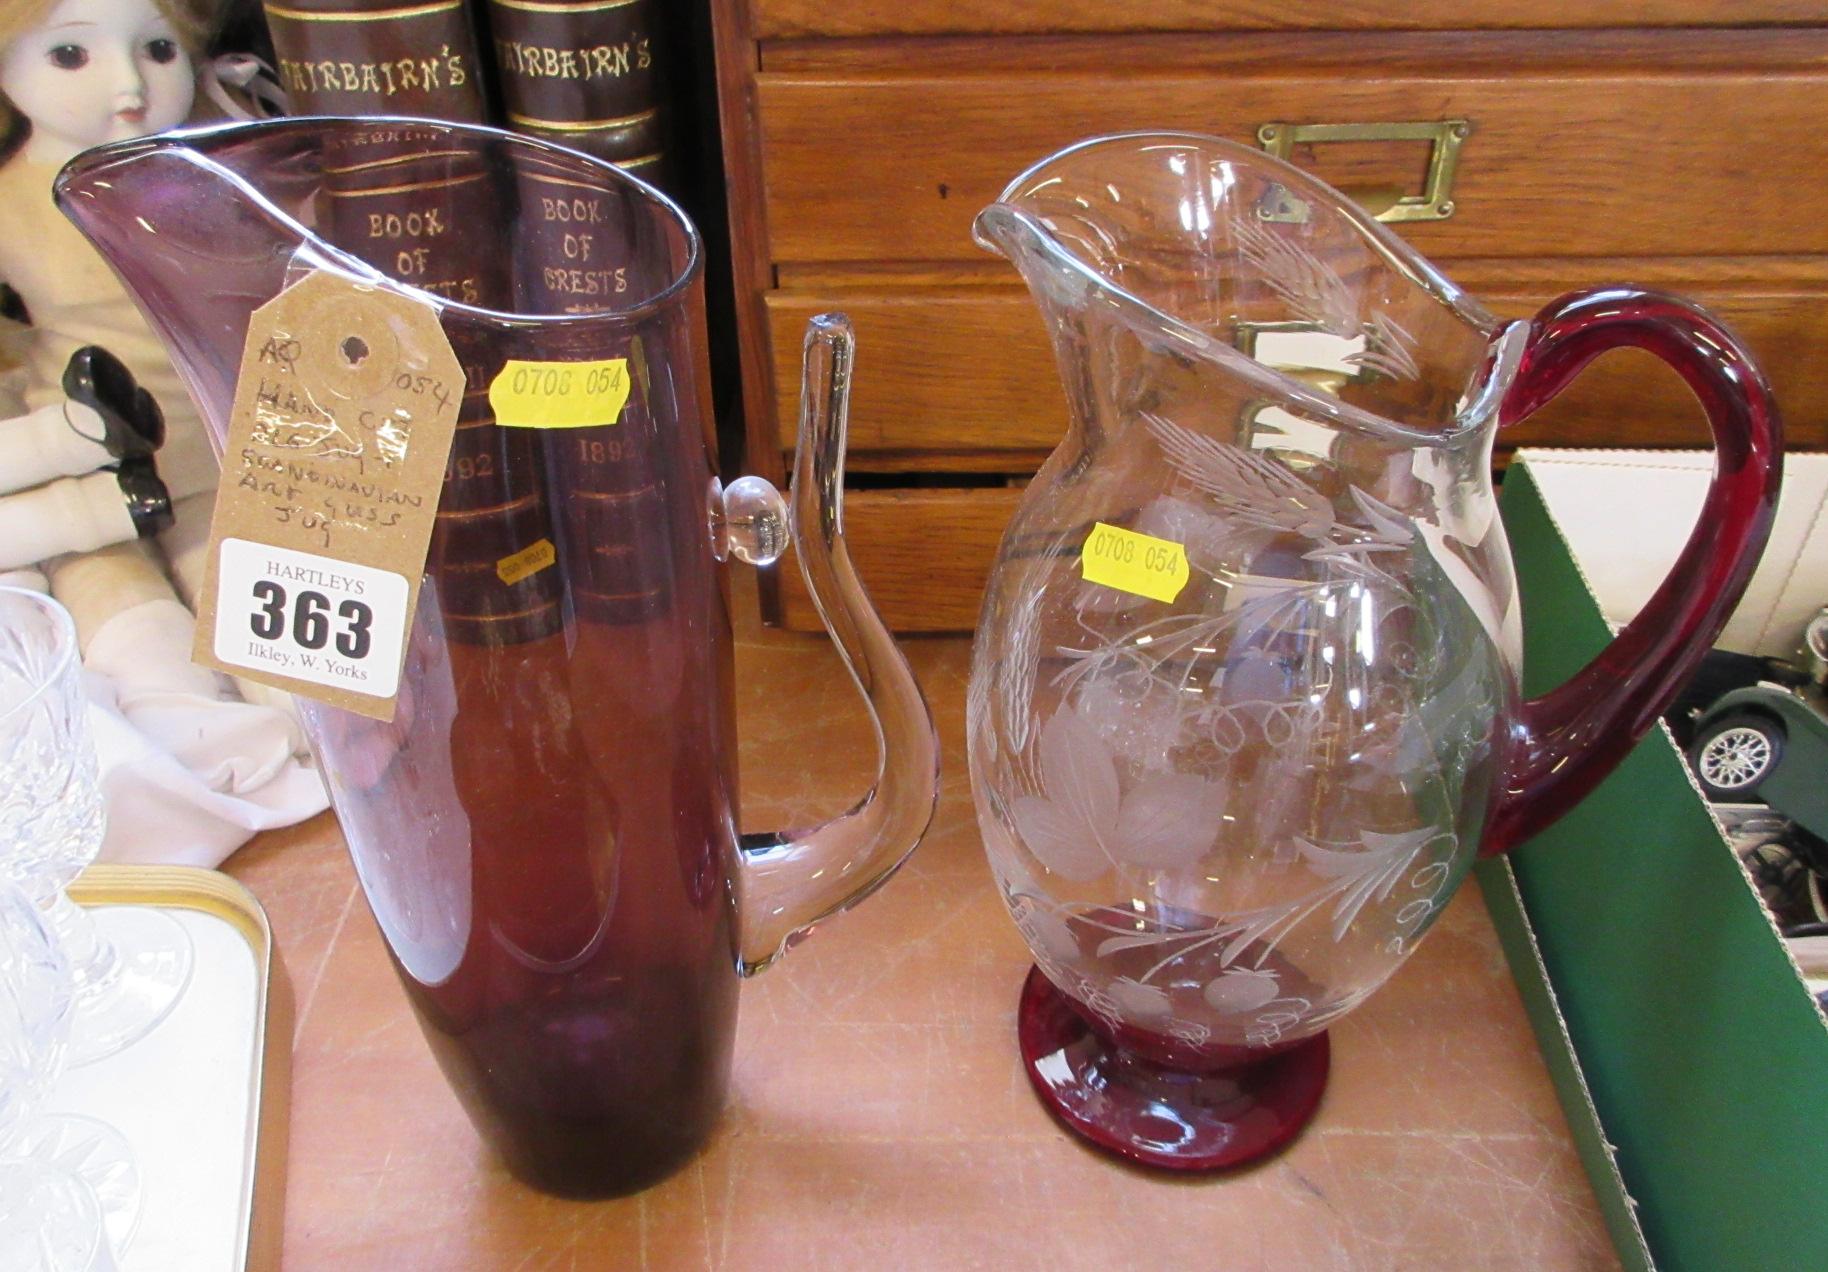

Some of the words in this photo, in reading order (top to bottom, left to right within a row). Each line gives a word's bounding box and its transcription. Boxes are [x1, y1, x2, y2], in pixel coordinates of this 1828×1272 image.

[369, 208, 444, 237] BOOK
[542, 198, 602, 223] BOOK
[397, 248, 430, 275] OF
[563, 233, 593, 261] OF
[543, 266, 627, 295] CRESTS
[396, 373, 453, 415] 054
[586, 366, 622, 395] 054
[1093, 531, 1136, 564] 0708
[1145, 546, 1178, 577] 054
[265, 560, 366, 595] HARTLEYS
[250, 579, 373, 660] 363
[247, 641, 295, 666] Ilkley,
[299, 653, 321, 671] W.
[324, 658, 368, 681] Yorks
